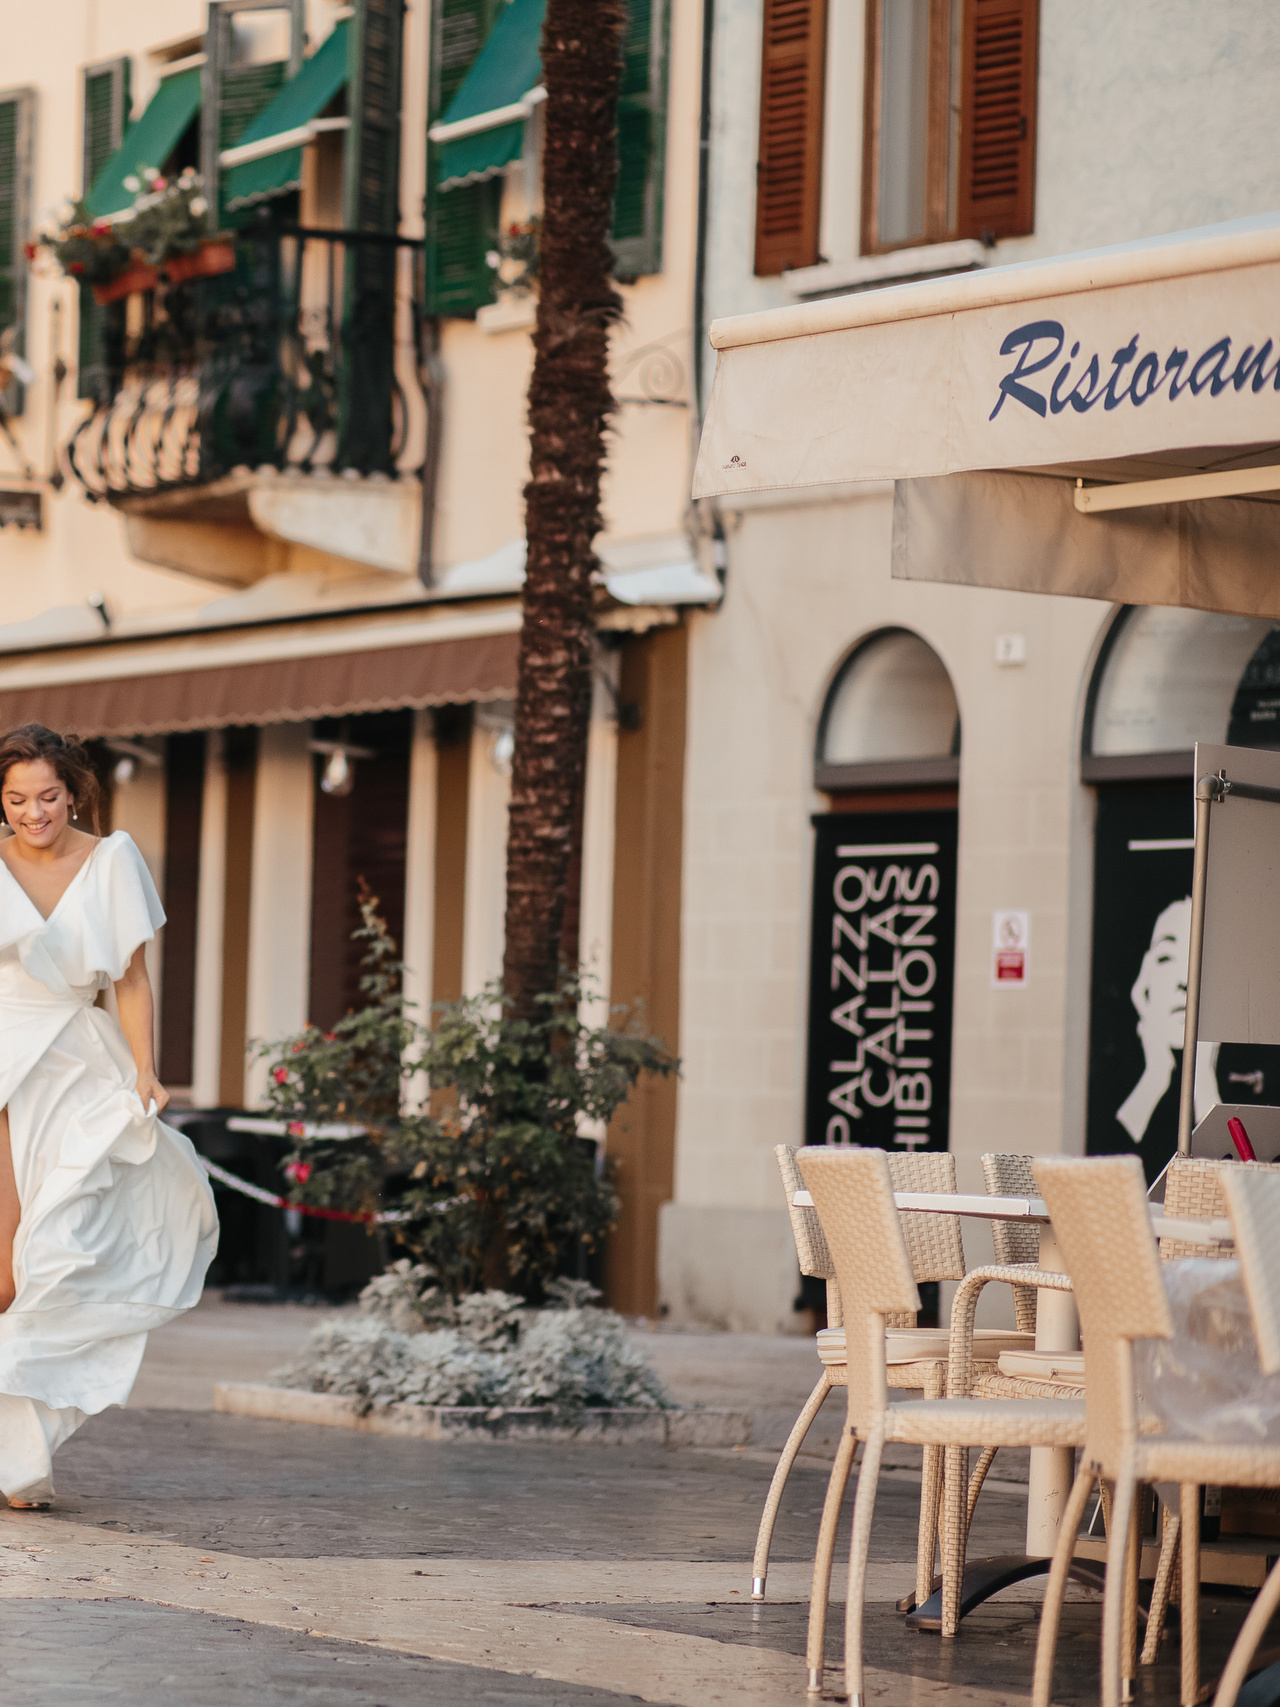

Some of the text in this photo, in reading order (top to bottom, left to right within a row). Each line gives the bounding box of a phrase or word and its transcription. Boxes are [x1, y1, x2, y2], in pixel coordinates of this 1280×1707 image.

[989, 320, 1280, 421] Ristoran
[826, 864, 870, 1147] PALAZZO
[860, 864, 904, 1108] CALLAS
